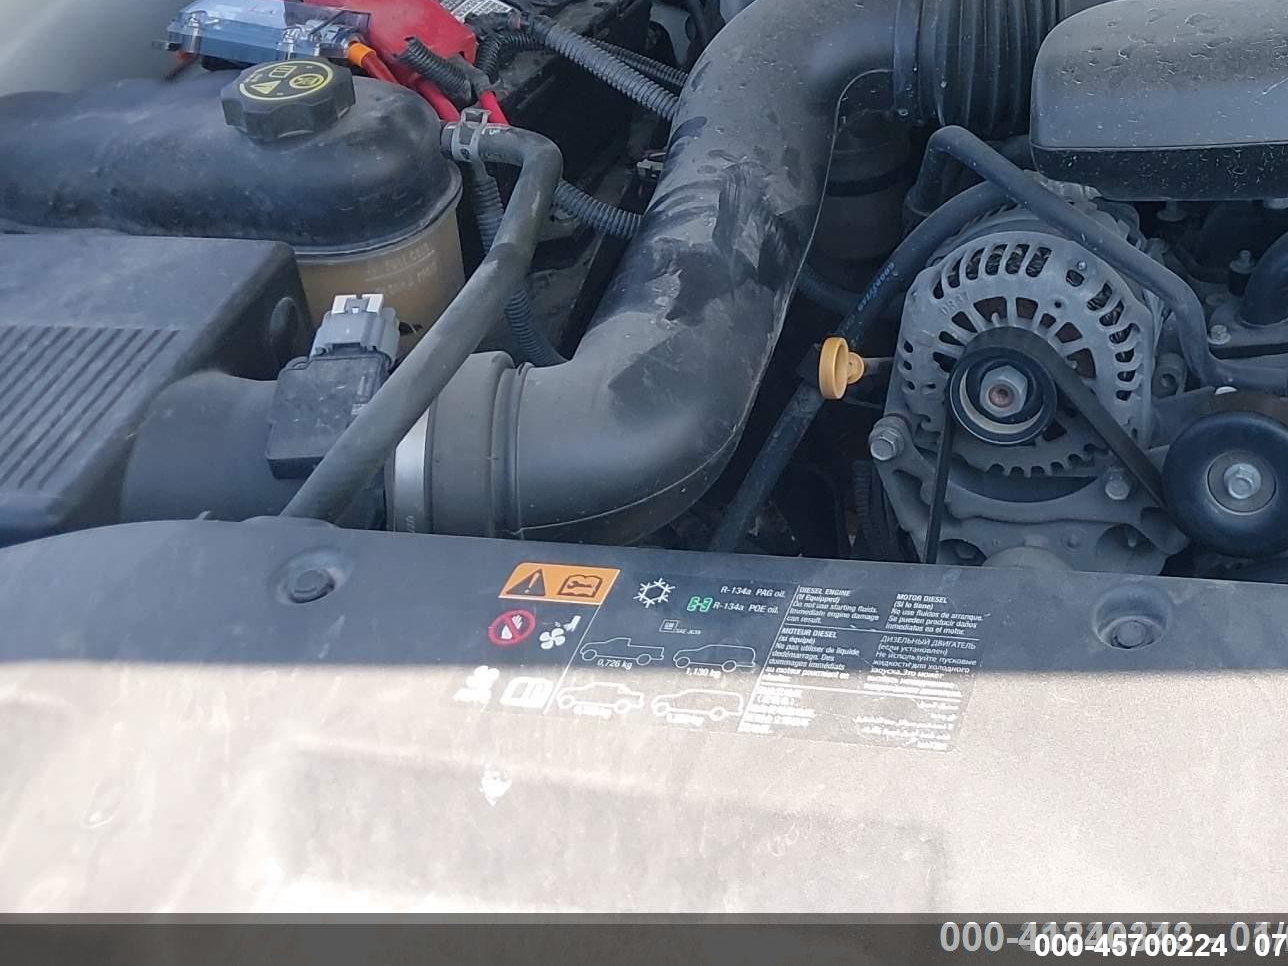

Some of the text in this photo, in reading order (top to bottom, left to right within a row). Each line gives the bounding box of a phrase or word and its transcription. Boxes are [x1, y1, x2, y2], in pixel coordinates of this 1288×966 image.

[720, 585, 752, 595] R-134a
[755, 588, 774, 597] PAG
[799, 586, 851, 597] DIESEL ENGINE
[805, 594, 841, 603] Equipped)
[896, 593, 922, 601] MOTOR
[712, 601, 745, 611] R-134a
[830, 604, 856, 612] starting
[789, 608, 880, 621] Immediate engine damage
[925, 618, 955, 627] producir
[782, 627, 838, 638] MOTEUR DIESEL
[880, 635, 977, 650] ДИЗЕЛЬНЫЙ ДВИГАТЕЛЬ
[621, 661, 633, 671] kg
